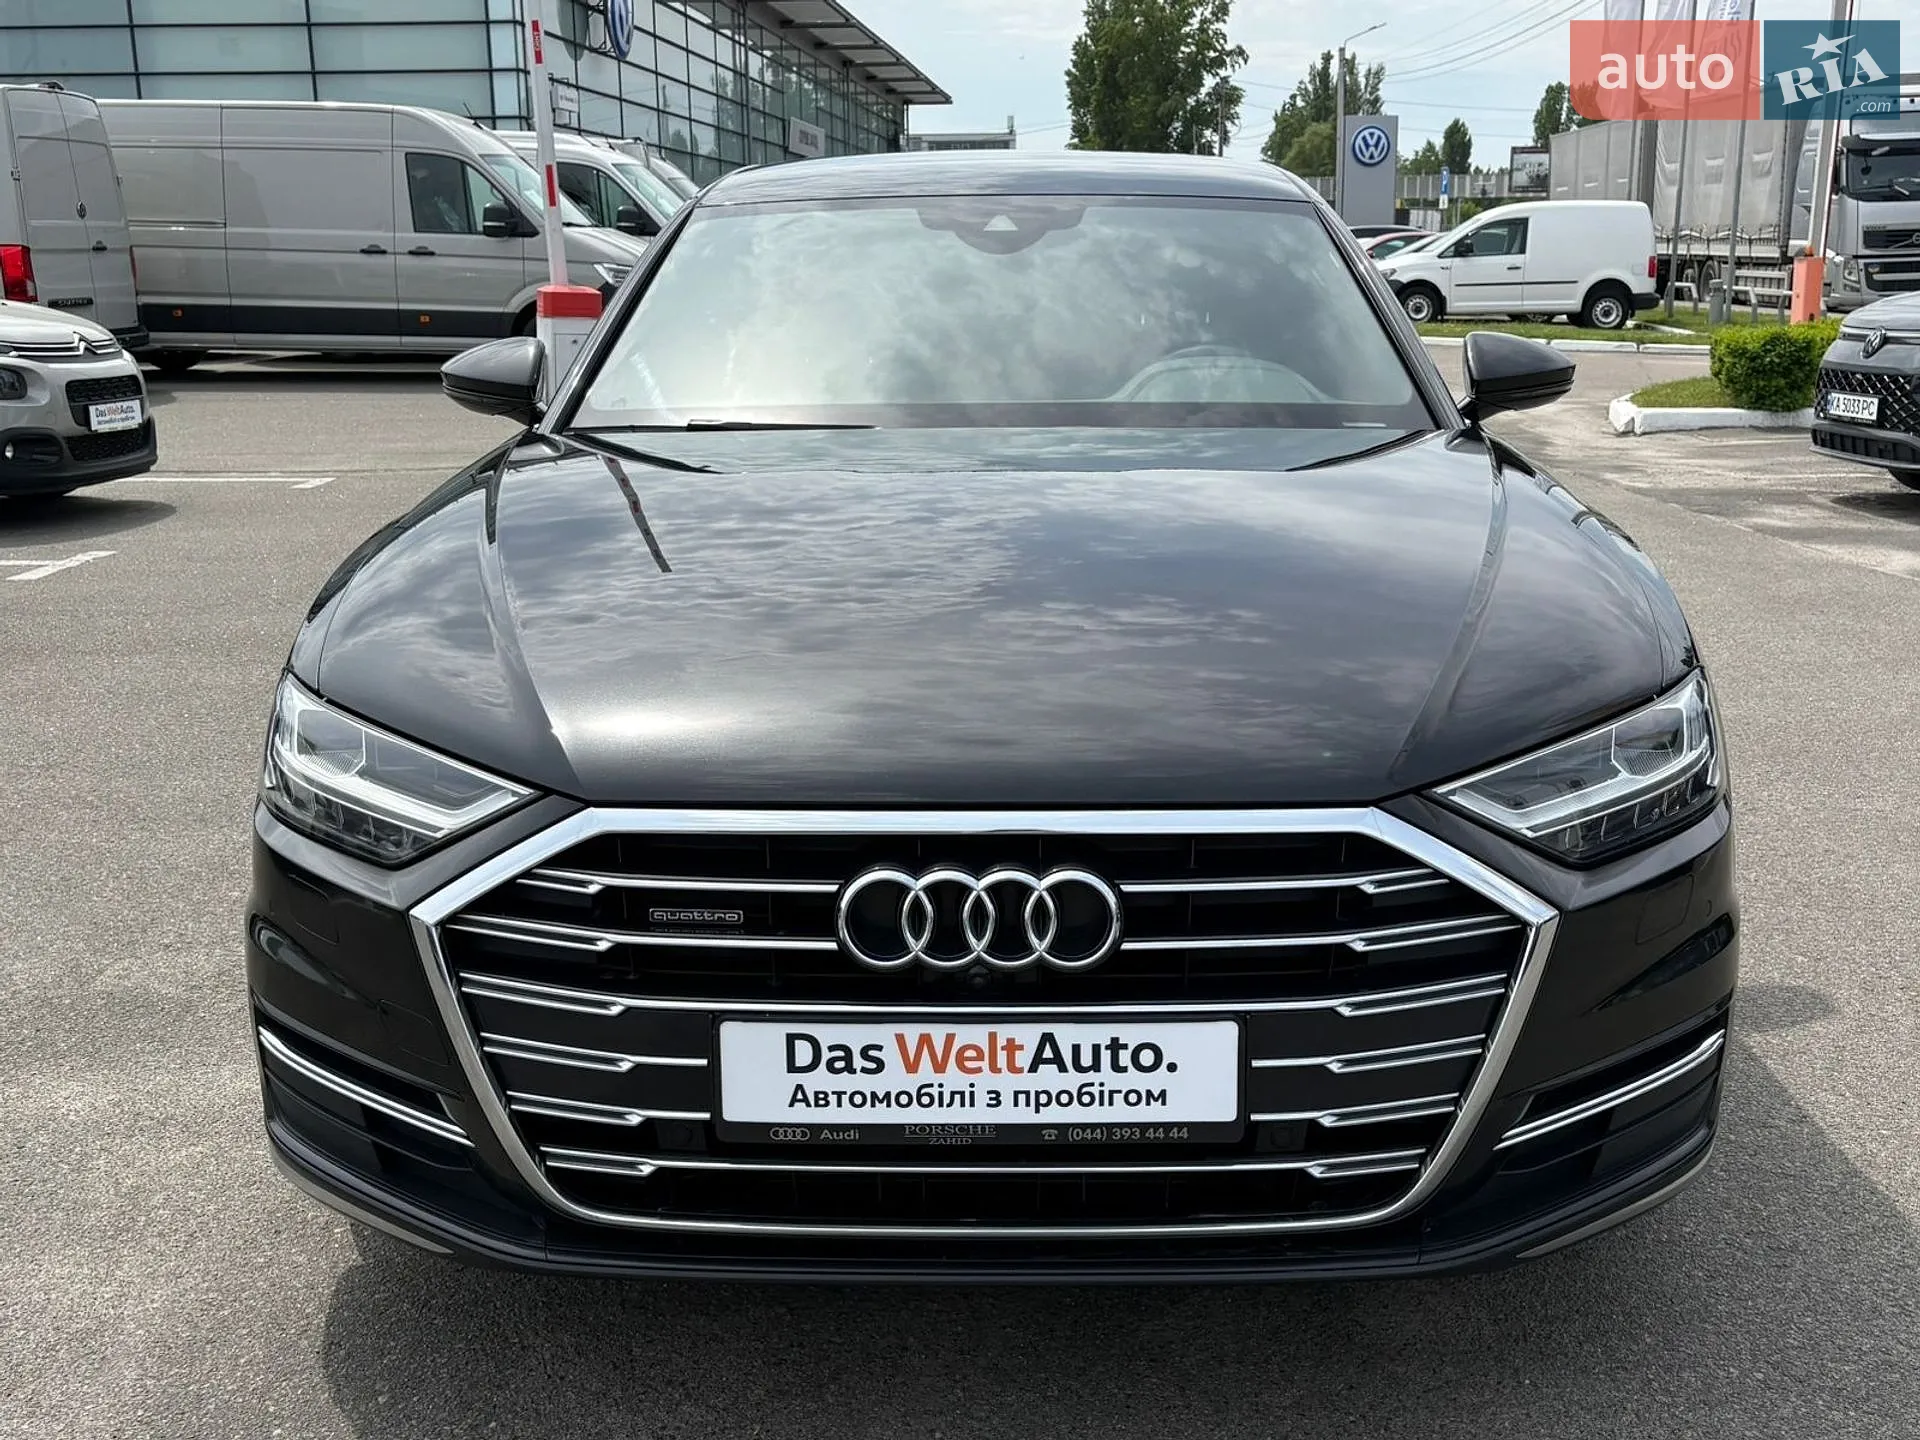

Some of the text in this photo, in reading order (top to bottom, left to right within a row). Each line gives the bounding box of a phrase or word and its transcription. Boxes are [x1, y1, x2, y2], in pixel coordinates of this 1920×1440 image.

[1861, 399, 1875, 416] PC
[653, 911, 739, 921] quattro
[785, 1032, 886, 1075] Das
[788, 1082, 1168, 1113] Автомобілі з пробігом
[819, 1128, 860, 1141] Audi
[903, 1125, 998, 1136] PORSCHE
[1067, 1126, 1189, 1142] (044) 393 44 44
[928, 1137, 973, 1145] ZAHID
